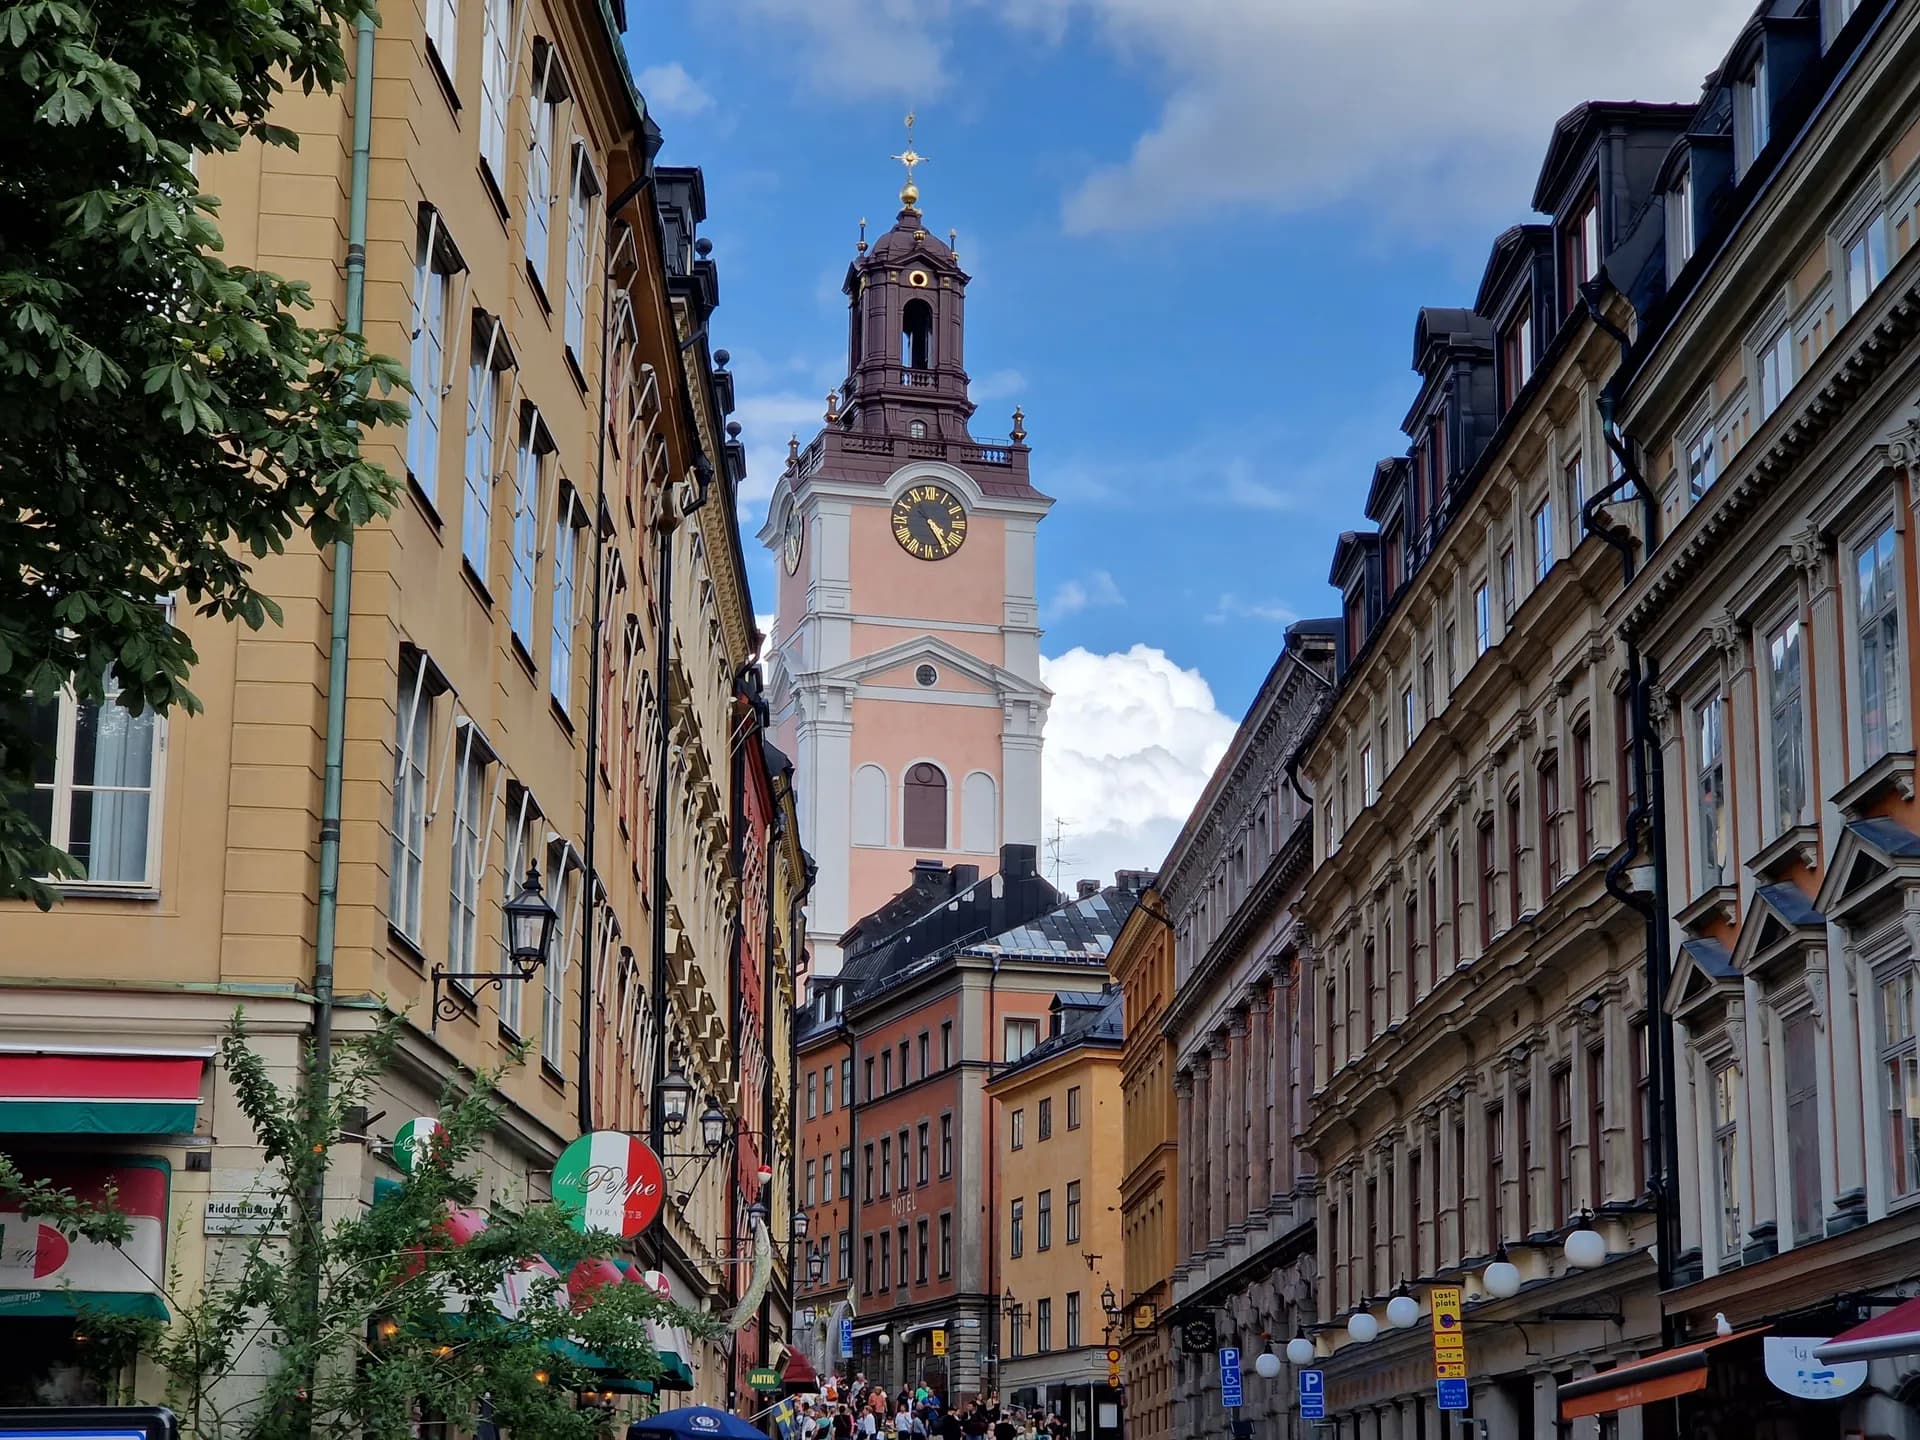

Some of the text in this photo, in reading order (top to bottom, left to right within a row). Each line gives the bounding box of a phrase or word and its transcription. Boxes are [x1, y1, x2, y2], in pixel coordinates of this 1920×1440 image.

[925, 486, 936, 500] XII
[577, 1165, 657, 1206] Peppe
[891, 1191, 917, 1217] HOTEL
[843, 1321, 850, 1329] P
[1224, 1350, 1235, 1365] P
[751, 1374, 775, 1384] ANTIK
[1305, 1373, 1319, 1392] P
